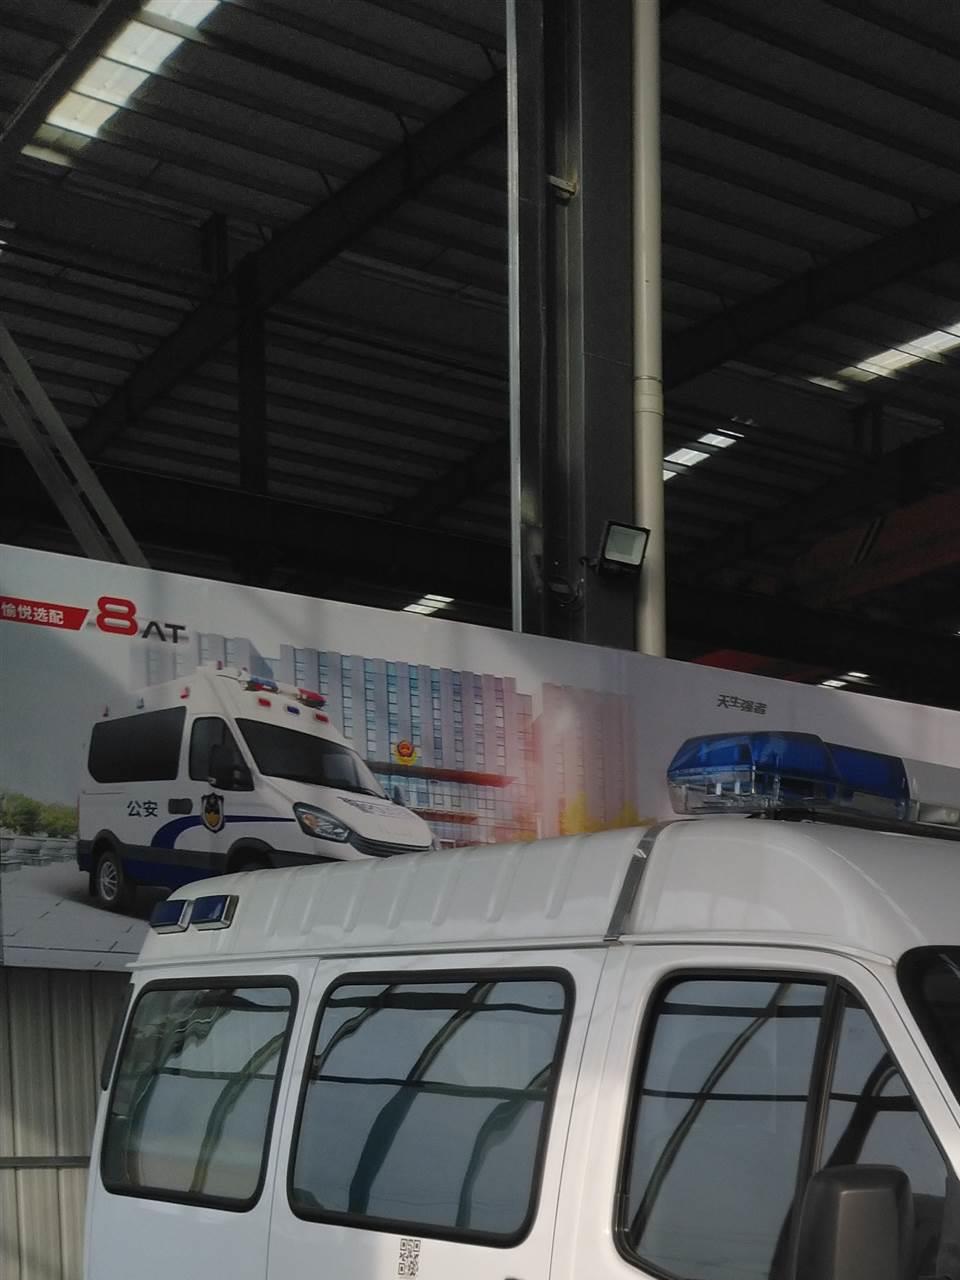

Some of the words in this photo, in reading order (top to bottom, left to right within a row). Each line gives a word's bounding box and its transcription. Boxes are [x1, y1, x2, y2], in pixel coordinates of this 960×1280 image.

[1, 602, 65, 625] 愉悦选配
[127, 800, 159, 818] 公安
